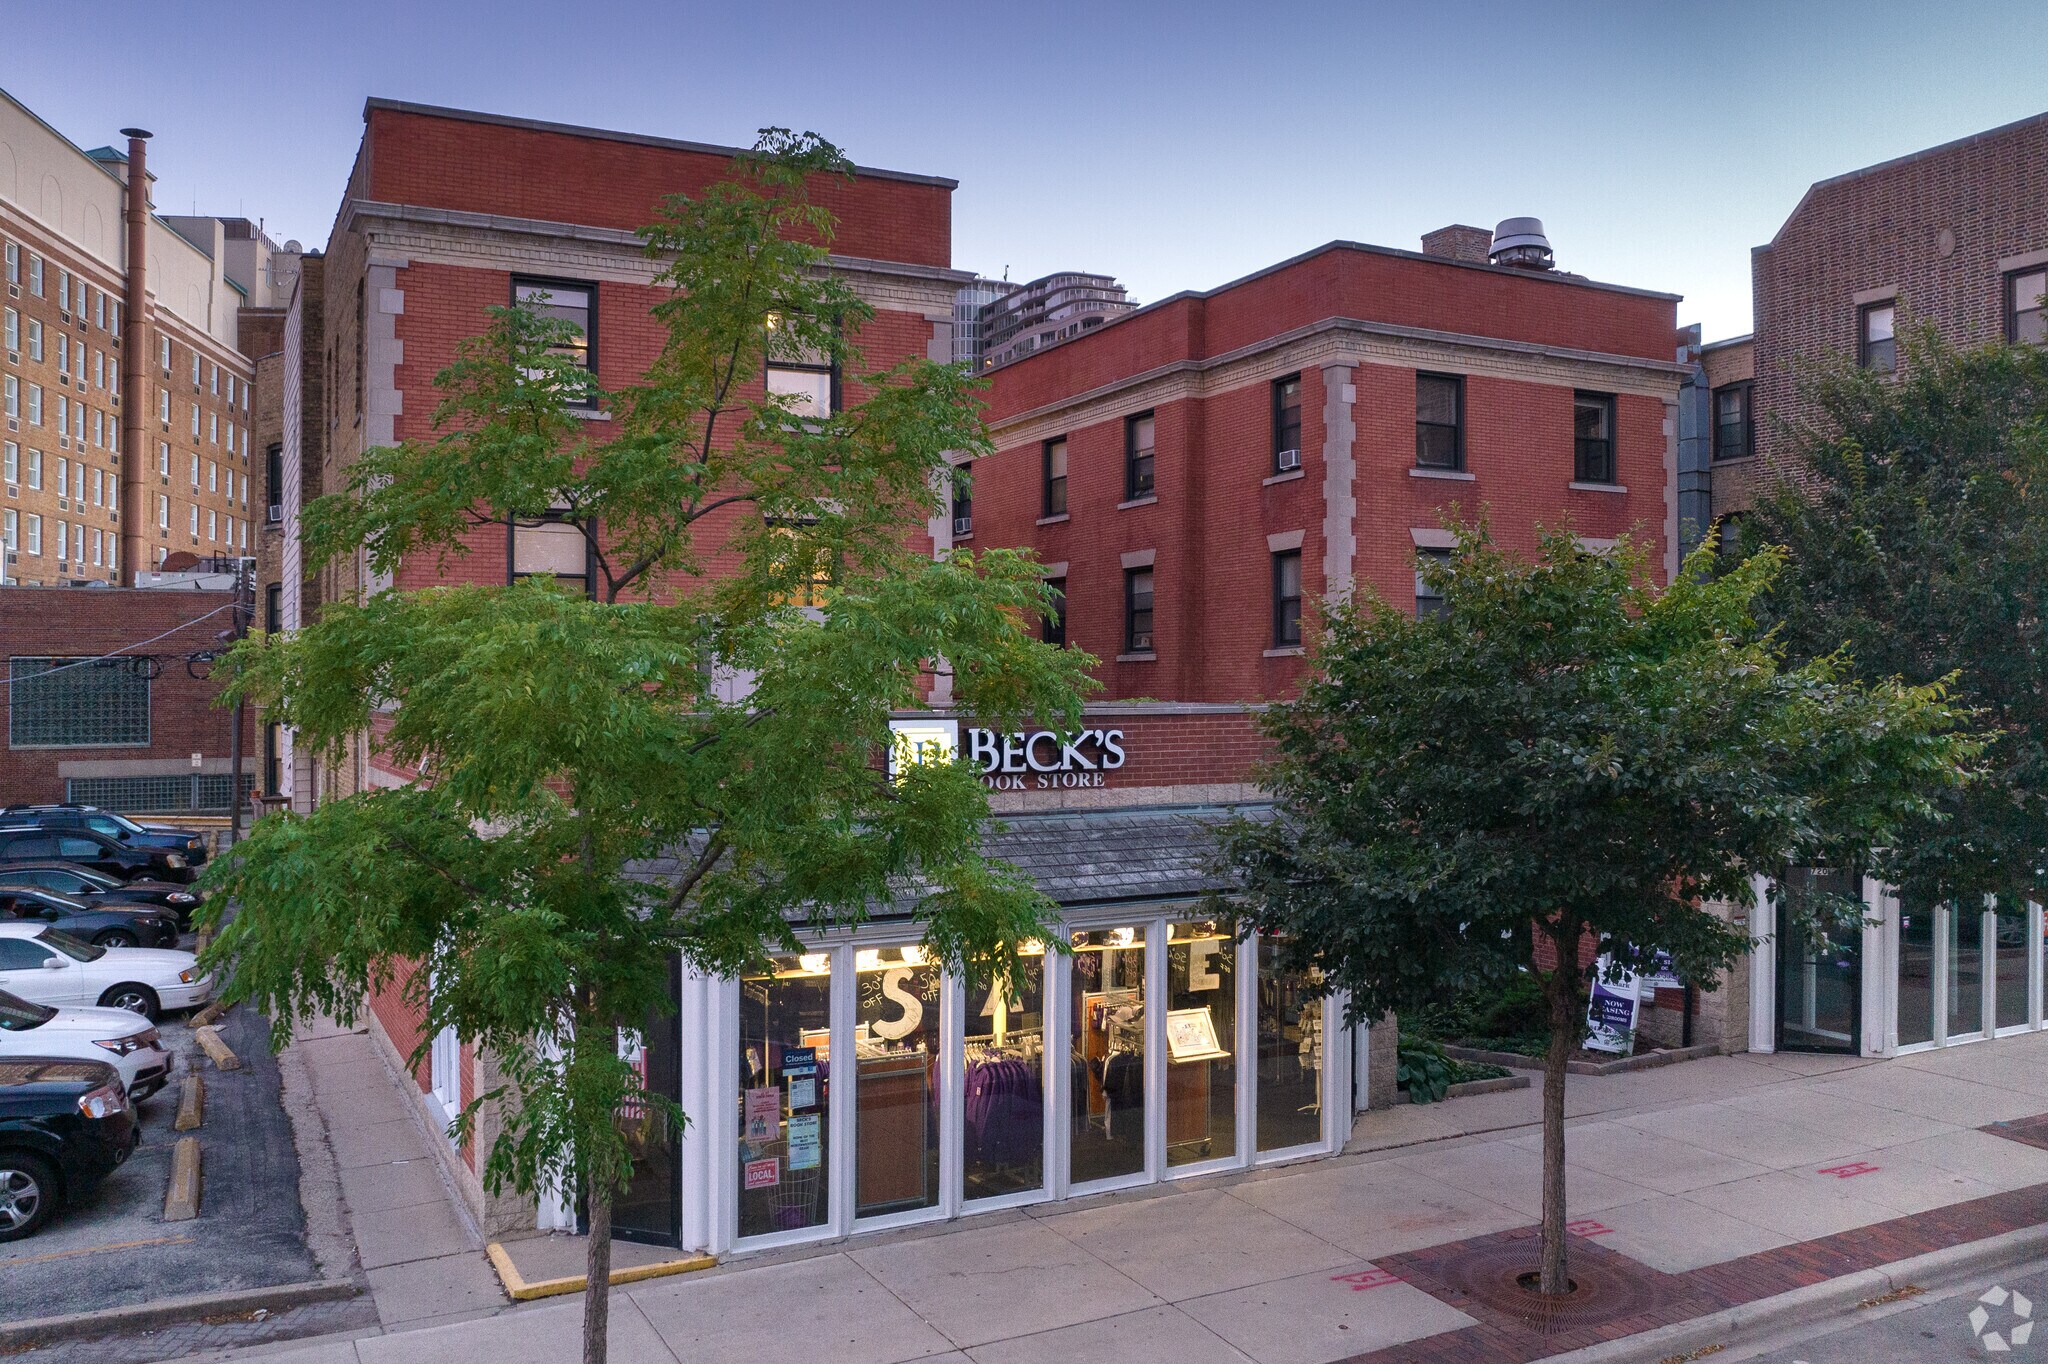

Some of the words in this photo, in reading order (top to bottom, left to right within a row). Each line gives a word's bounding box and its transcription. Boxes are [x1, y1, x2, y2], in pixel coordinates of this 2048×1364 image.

[968, 728, 1126, 773] BECK'S
[980, 774, 1027, 790] OOK
[1037, 772, 1105, 789] STORE
[1811, 867, 1828, 875] 720
[863, 993, 883, 1008] OFF
[921, 989, 939, 1001] OFF
[1604, 999, 1625, 1008] NOW
[785, 1053, 813, 1063] Closed
